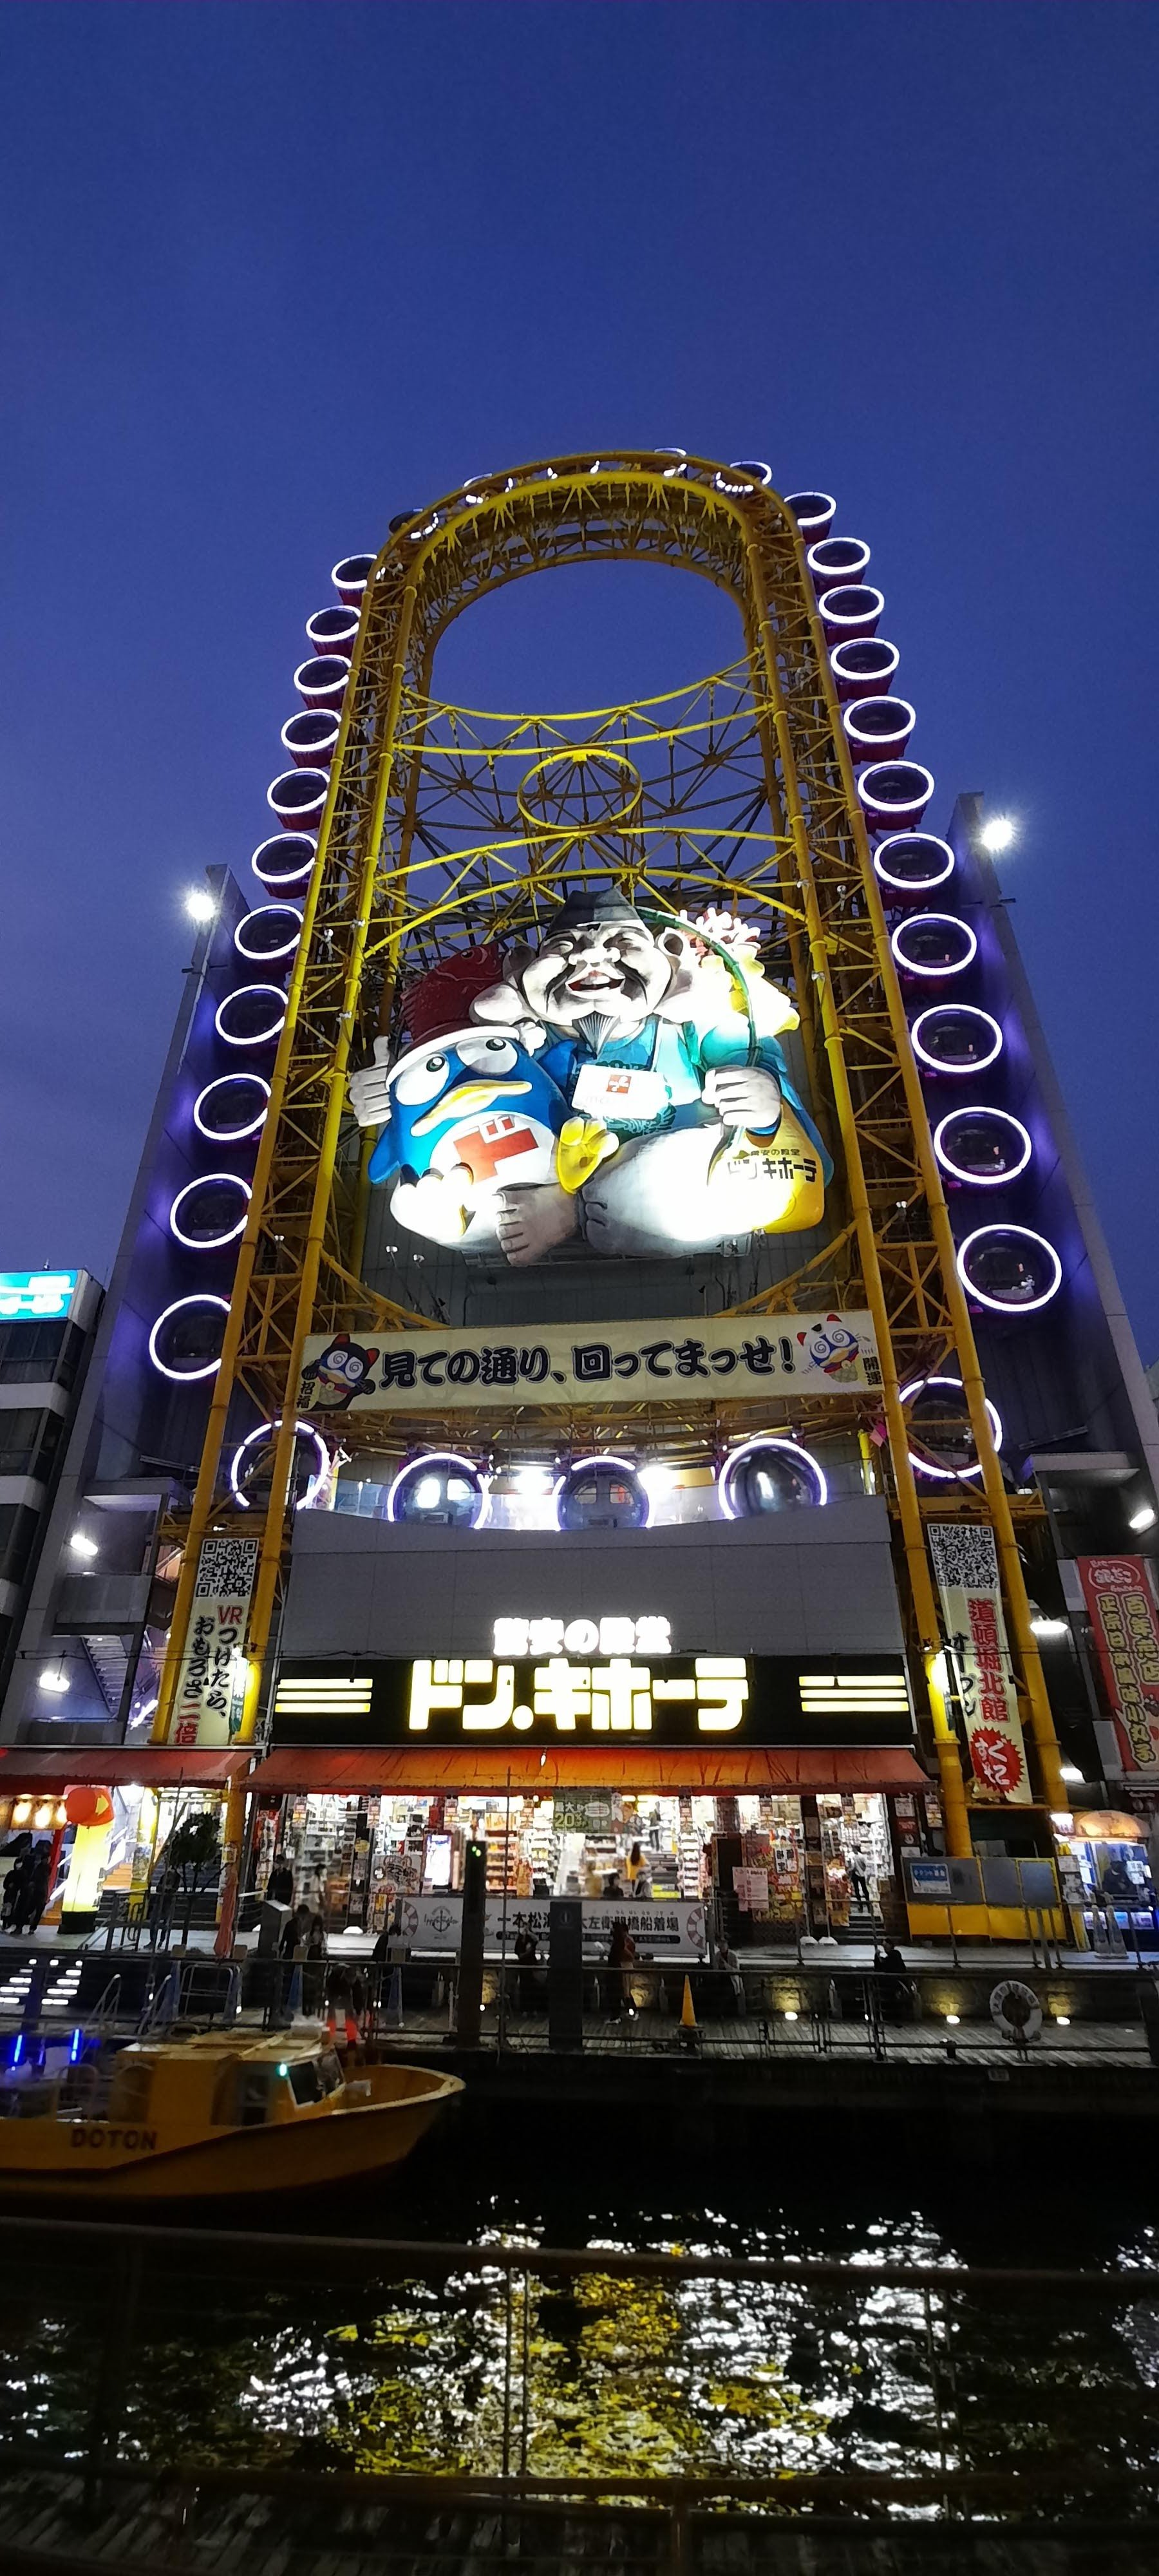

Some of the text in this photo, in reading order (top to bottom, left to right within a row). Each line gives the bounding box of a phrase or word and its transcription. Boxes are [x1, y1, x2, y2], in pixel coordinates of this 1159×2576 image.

[862, 1356, 882, 1386] 開運
[296, 1381, 315, 1409] 招福
[968, 1598, 1010, 1723] 道頓堀北館
[173, 1615, 215, 1745] おもろさ二倍
[71, 2126, 158, 2150] DOTON
